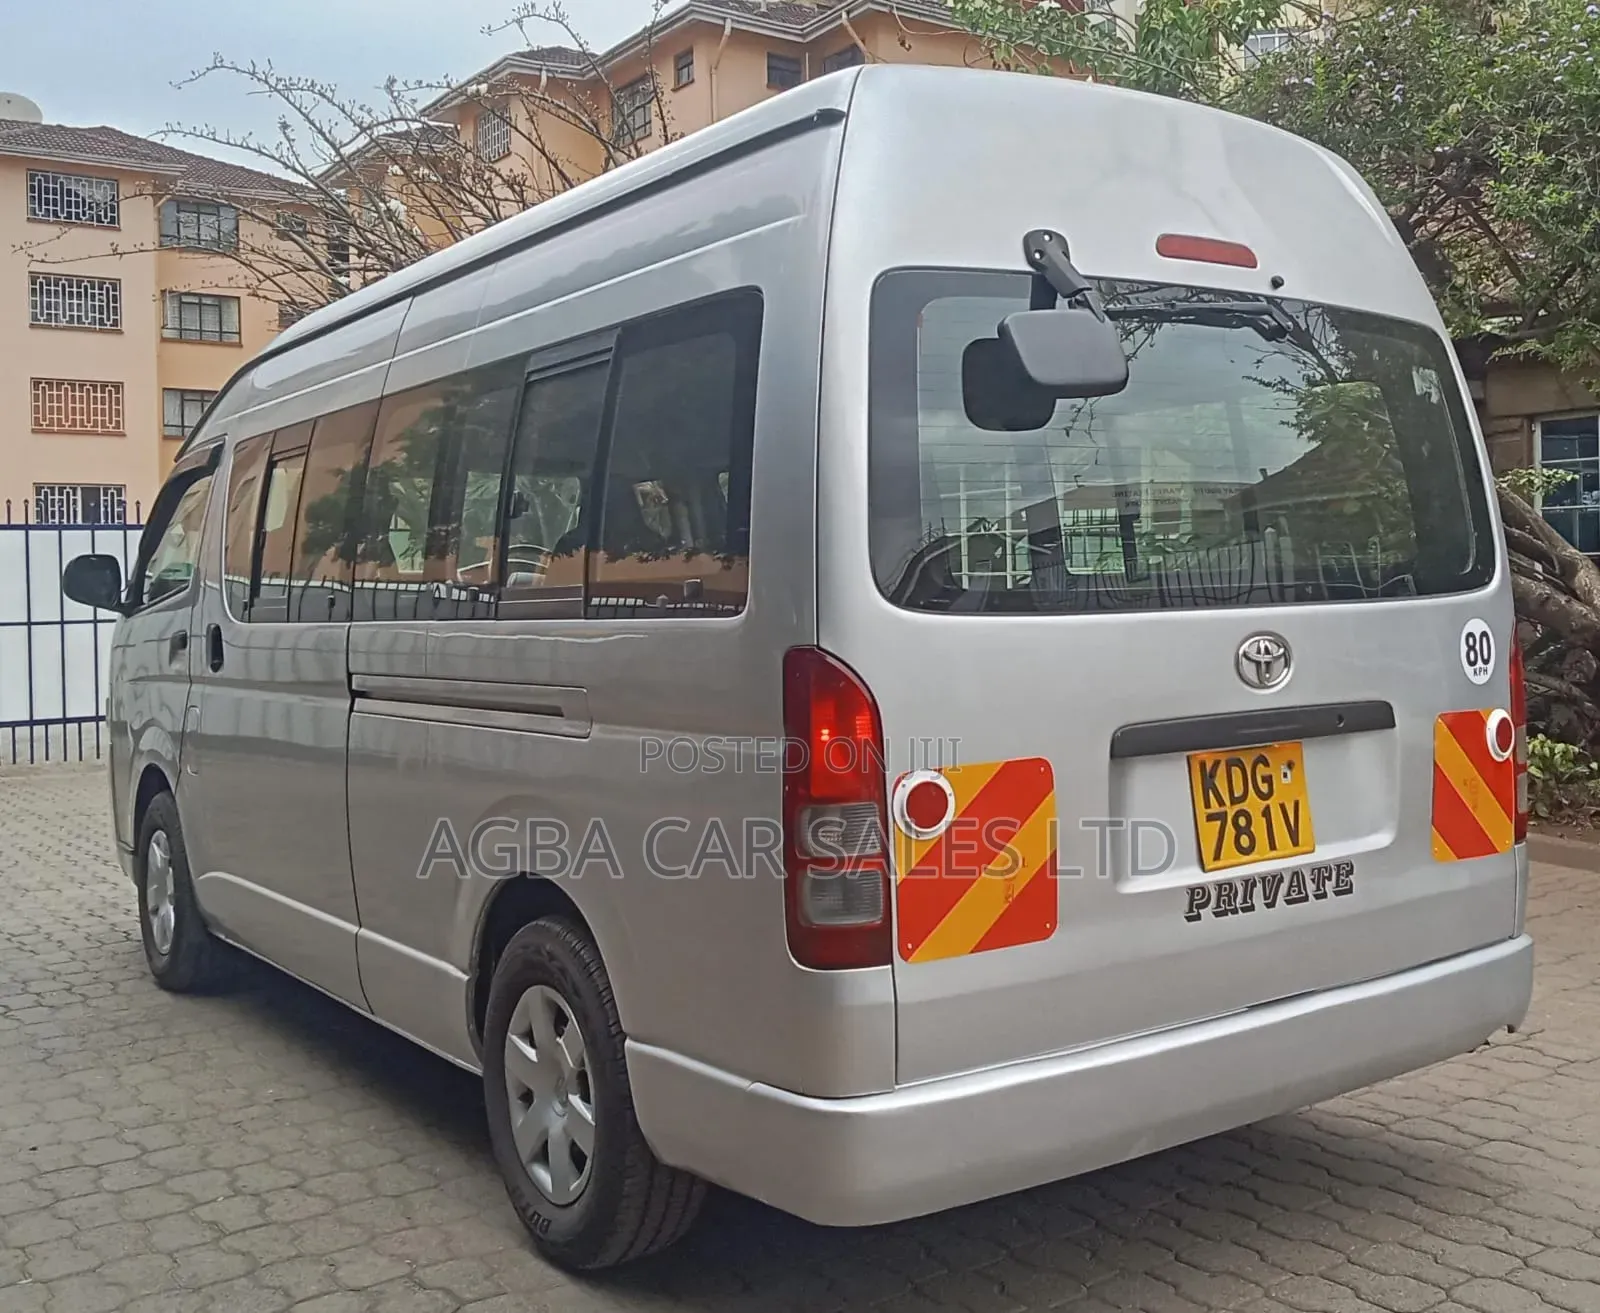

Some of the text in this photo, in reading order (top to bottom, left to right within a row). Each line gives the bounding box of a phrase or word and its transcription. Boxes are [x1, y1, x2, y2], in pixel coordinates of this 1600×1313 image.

[1465, 630, 1491, 667] 80
[1473, 666, 1488, 677] KPH
[1199, 754, 1275, 810] KDG
[1205, 799, 1300, 861] 781V
[1184, 860, 1354, 922] PRIVATE
